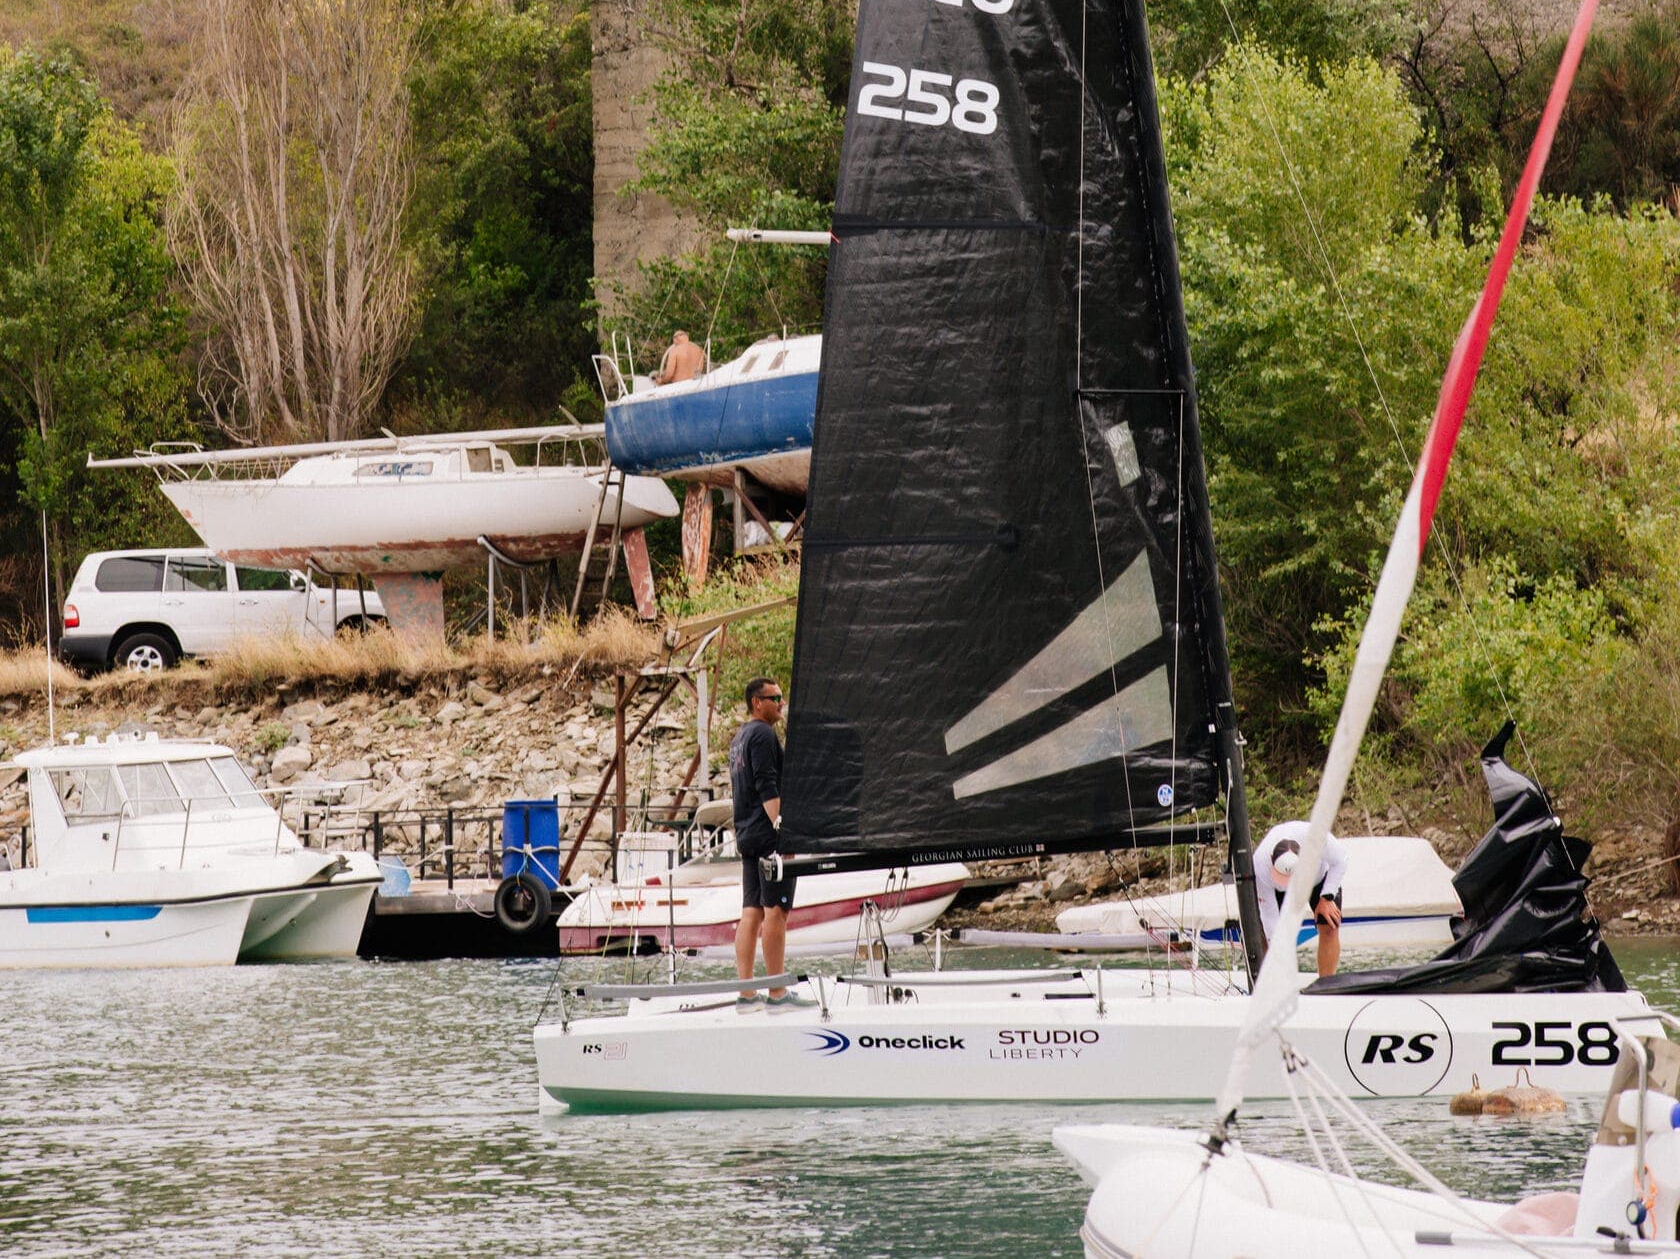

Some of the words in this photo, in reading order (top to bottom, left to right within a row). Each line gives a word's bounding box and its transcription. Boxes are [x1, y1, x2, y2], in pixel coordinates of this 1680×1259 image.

[857, 61, 1001, 135] 258
[911, 850, 963, 863] GEORGIAN
[966, 846, 1005, 858] SAILING
[1008, 843, 1034, 855] CLUB
[858, 1035, 966, 1050] Oneclick
[998, 1029, 1100, 1045] STUDIO
[1491, 1021, 1620, 1066] 258
[583, 1044, 602, 1053] RS
[989, 1048, 1082, 1060] LIBERTY
[1361, 1033, 1438, 1063] RS
